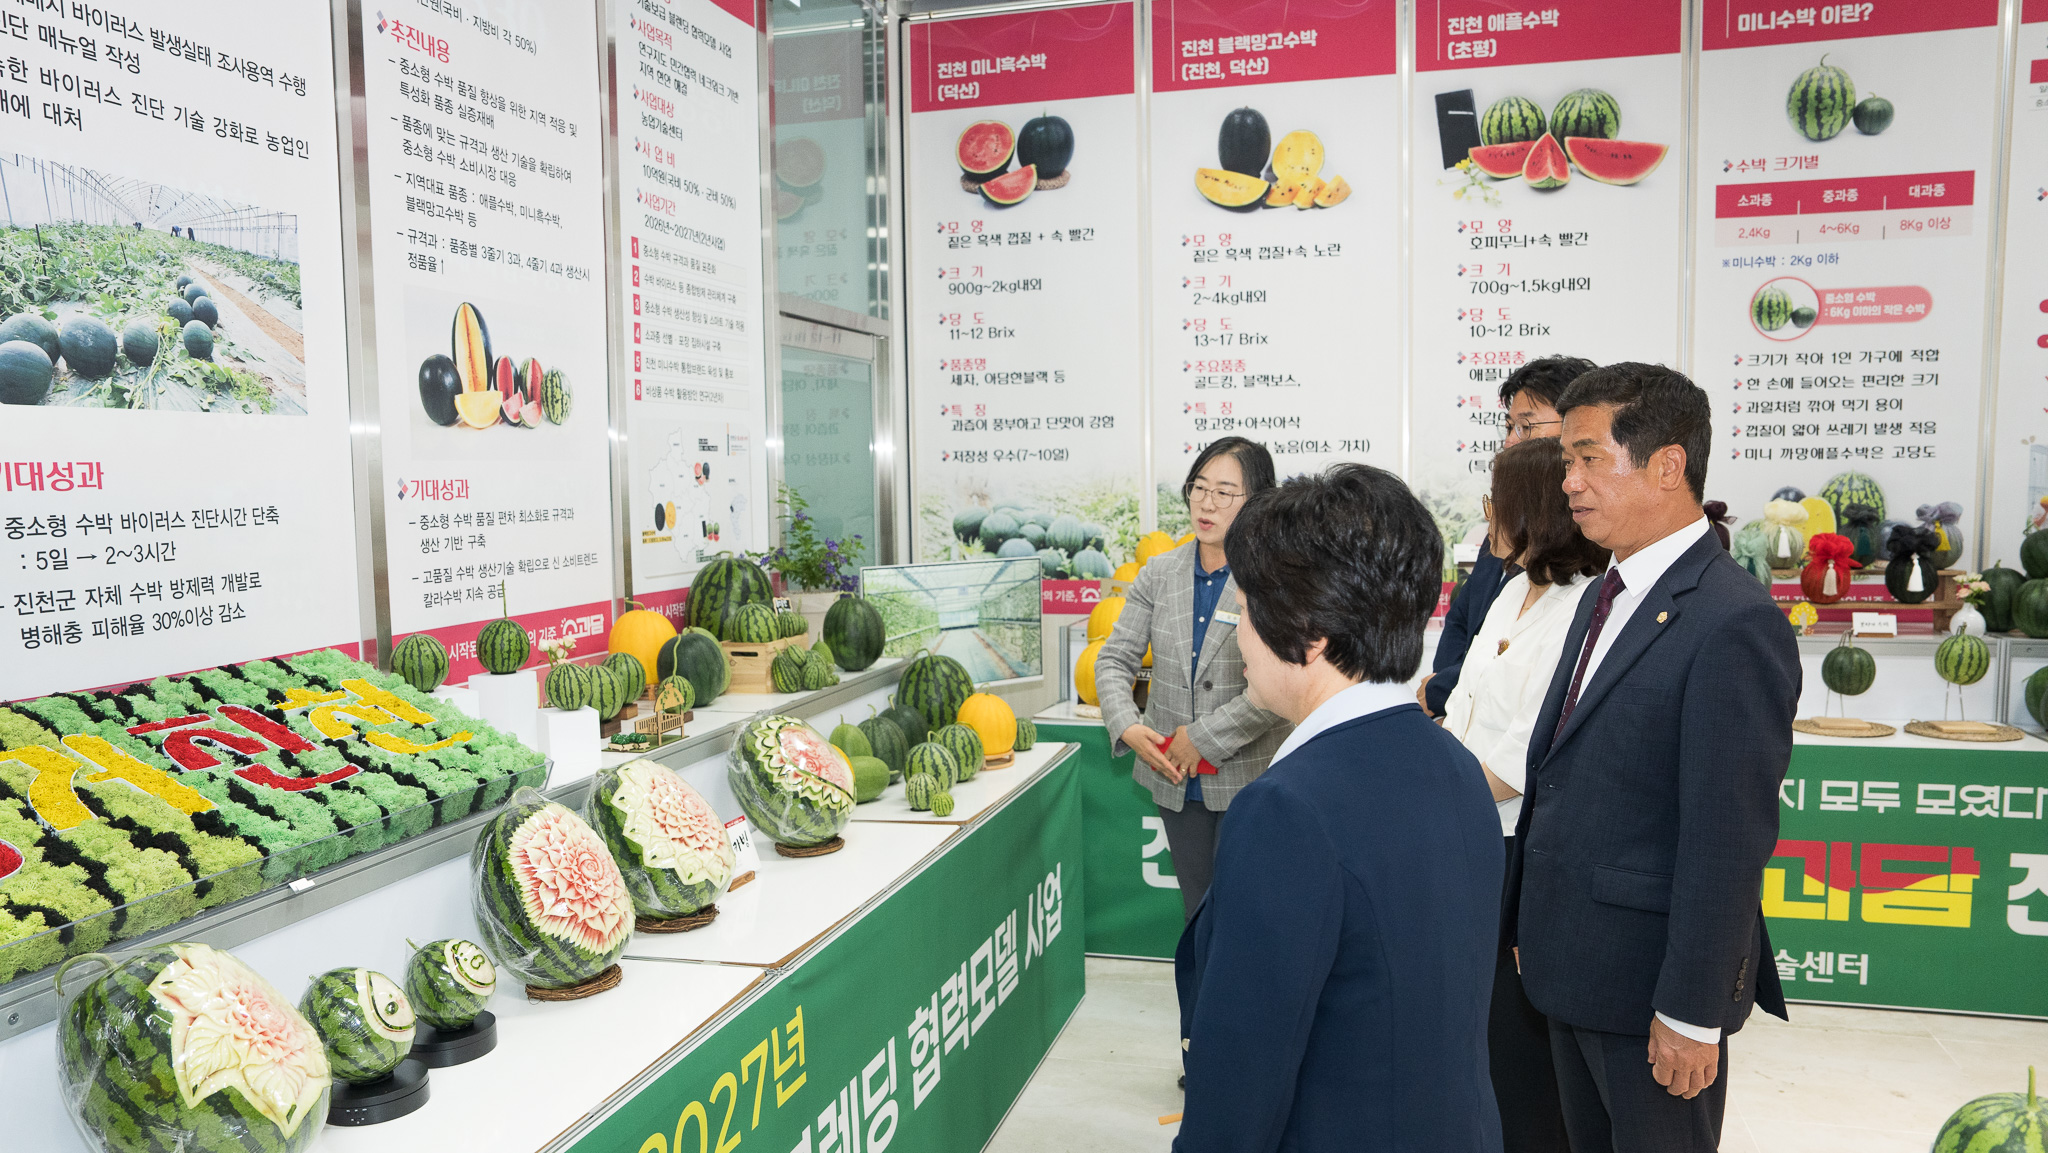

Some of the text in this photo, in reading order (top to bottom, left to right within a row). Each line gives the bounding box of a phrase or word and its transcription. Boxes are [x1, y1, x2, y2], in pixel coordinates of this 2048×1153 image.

[1448, 9, 1559, 35] 진천 애플수박
[1738, 3, 1873, 31] 미니수박 이란?
[391, 19, 450, 63] 추진내용
[638, 19, 672, 51] 사업목적
[1182, 30, 1317, 57] 진천 블랙망고수박
[38, 25, 140, 74] 매뉴얼 작성
[72, 2, 144, 42] 바이러스
[150, 28, 211, 67] 발생실태
[218, 53, 273, 87] 조사용역
[279, 73, 305, 96] 수행
[1448, 39, 1496, 60] (초평)
[938, 53, 1047, 79] 진천 미니흑수박
[1182, 57, 1269, 81] (진천, 덕산)
[400, 58, 577, 137] 중소형 수박 품질 향상을 위한 지역 적응 및
[938, 82, 979, 101] (덕산)
[40, 67, 308, 159] 바이러스 진단 기술 강화로 농업인
[641, 90, 674, 118] 사업대상
[43, 103, 82, 131] 대처
[642, 111, 682, 141] 농업기술센터
[1737, 155, 1818, 173] 수박 크기별
[684, 180, 699, 196] 50%
[1823, 189, 1858, 203] 중과종
[1909, 183, 1945, 197] 대과종
[644, 192, 675, 216] 사업기간
[1738, 193, 1772, 206] 소과종
[1900, 217, 1951, 231] 8Kg 이상
[948, 228, 1094, 249] 짙은 흑색 껍질 속 빨간
[1471, 232, 1588, 249] 호피무늬+속 빨간
[408, 253, 437, 272] 정품율
[1733, 253, 1839, 268] 미니수박 2Kg 이하
[950, 327, 1014, 340] 11~12 Brix
[1195, 334, 1267, 346] 13~17 Brix
[1471, 324, 1549, 337] 10~12 Brix
[951, 359, 986, 371] 품종명
[1196, 360, 1245, 373] 주요품종
[1469, 352, 1526, 364] 주요품종
[1749, 349, 1939, 366] 크기가 작아 1인 가구에 적합
[1195, 374, 1301, 389] 골드킹, 블랙보스,
[1747, 374, 1938, 390] 한 손에 들어오는 편리한 크기
[1748, 399, 1902, 413] 과일처럼 깎아 먹기 용이
[953, 416, 1114, 431] 과즙이 풍부하고 단맛이 강함
[1195, 417, 1300, 430] 망고향+아삭아삭
[1747, 422, 1936, 437] 껍질이 얇아 쓰레기 발생 적음
[1745, 446, 1935, 460] 미니 까망애플수박은 고당도
[411, 480, 469, 501] 기대성과
[5, 506, 279, 539] 중소형 수박 바이러스 진단시간 단축
[420, 508, 574, 530] 중소형 수박 품질 편차 최소화로 규격과
[421, 535, 485, 553] 생산 기반 구축
[37, 548, 68, 570] 5일
[14, 572, 261, 615] 진천군 자체 수박 방제력 개발로
[21, 603, 246, 649] 병해충 피해율 30%이상 감소
[1820, 780, 1901, 814] 모두
[1915, 783, 2048, 820] 모였다
[908, 862, 1062, 1110] 협력모델 사업
